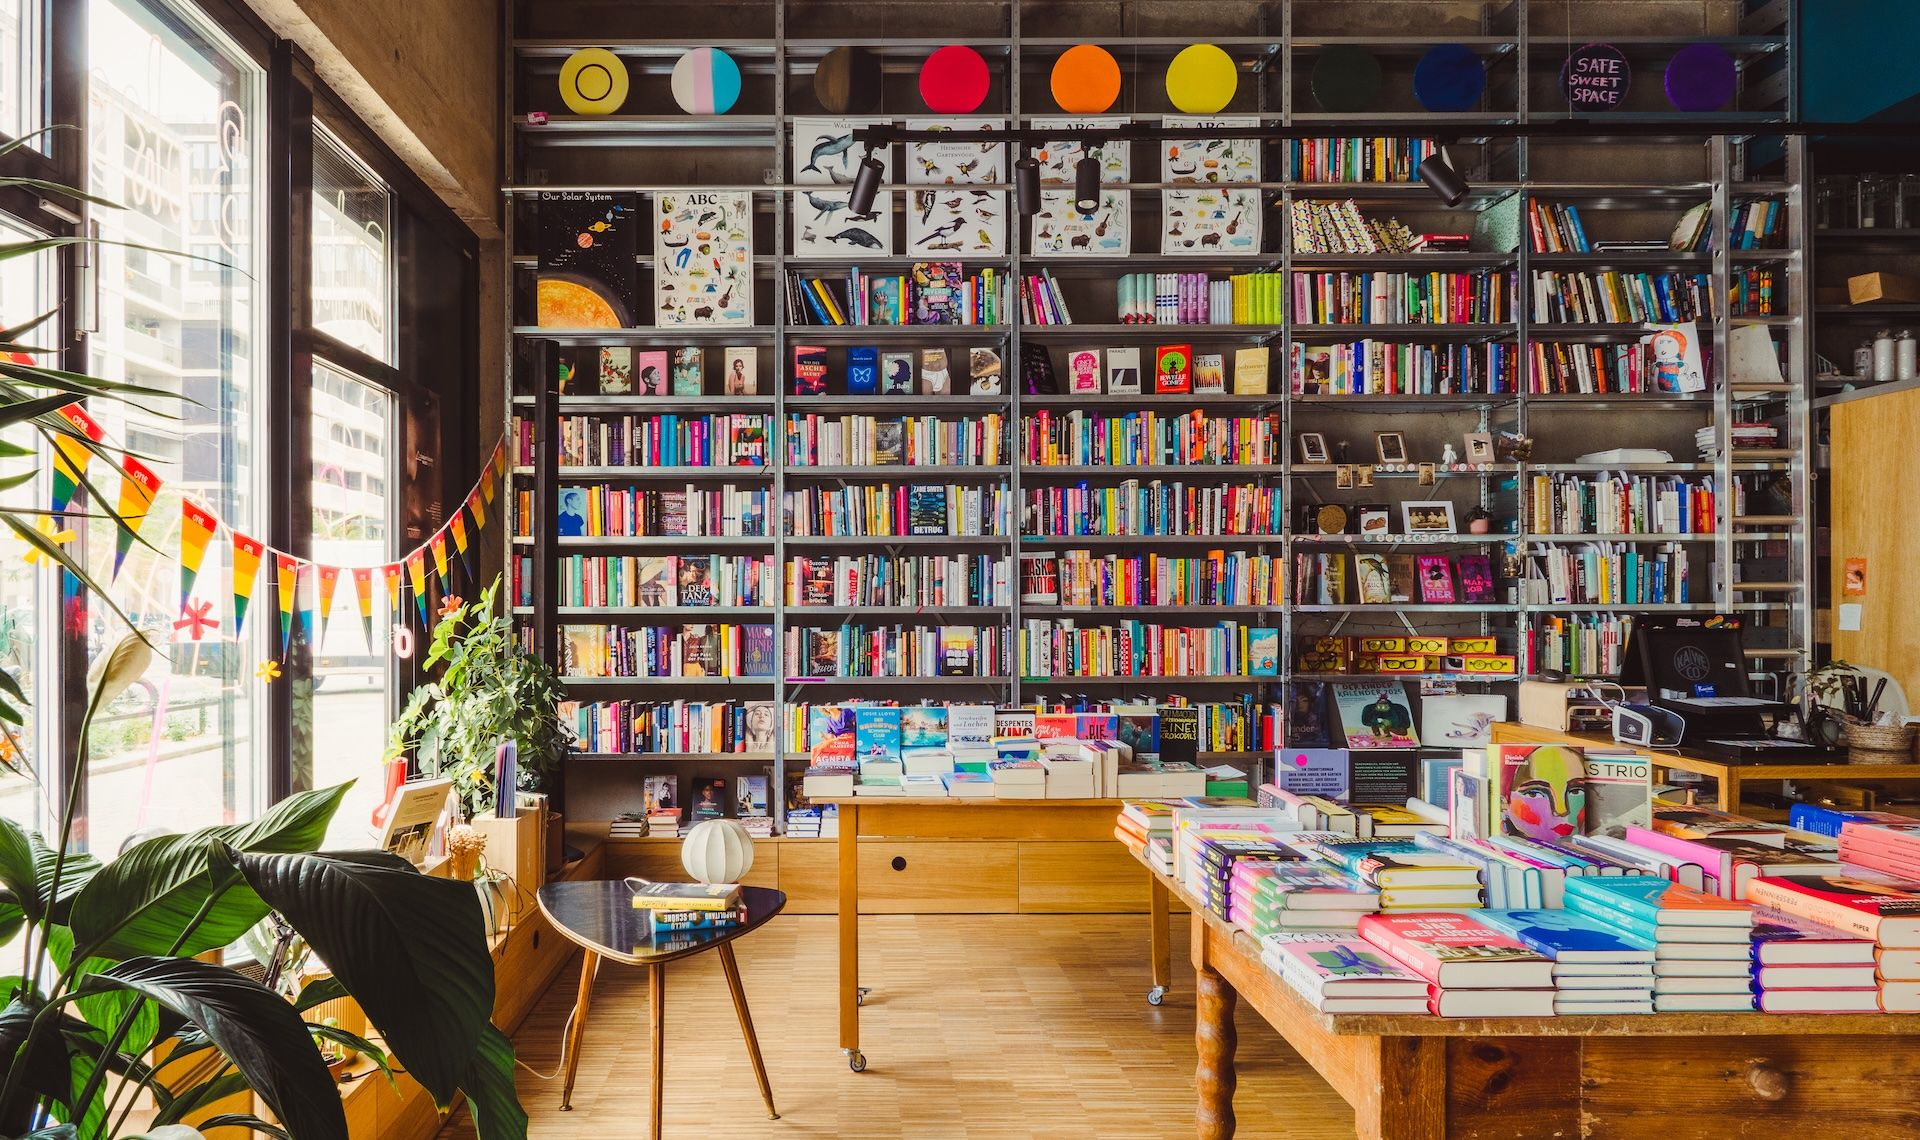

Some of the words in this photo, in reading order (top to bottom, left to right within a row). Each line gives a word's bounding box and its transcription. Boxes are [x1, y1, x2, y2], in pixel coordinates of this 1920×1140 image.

[1576, 58, 1622, 74] SAFE
[1569, 74, 1622, 88] SWEET
[1572, 88, 1620, 104] SPACE
[542, 192, 560, 200] Our
[562, 192, 583, 200] Solar
[585, 192, 612, 202] System
[686, 194, 718, 205] ABC
[732, 418, 762, 428] SCHLAG
[732, 442, 762, 456] LICHT
[1030, 559, 1048, 575] ASK
[1030, 577, 1048, 594] NOT
[1464, 579, 1492, 588] MAN'S
[1338, 689, 1381, 697] KALENDER
[1604, 765, 1647, 778] TRIO
[664, 913, 688, 923] SCHÖNE
[688, 912, 697, 921] DU
[1852, 922, 1870, 932] PIPER
[1402, 929, 1500, 937] GEFLÜSTER
